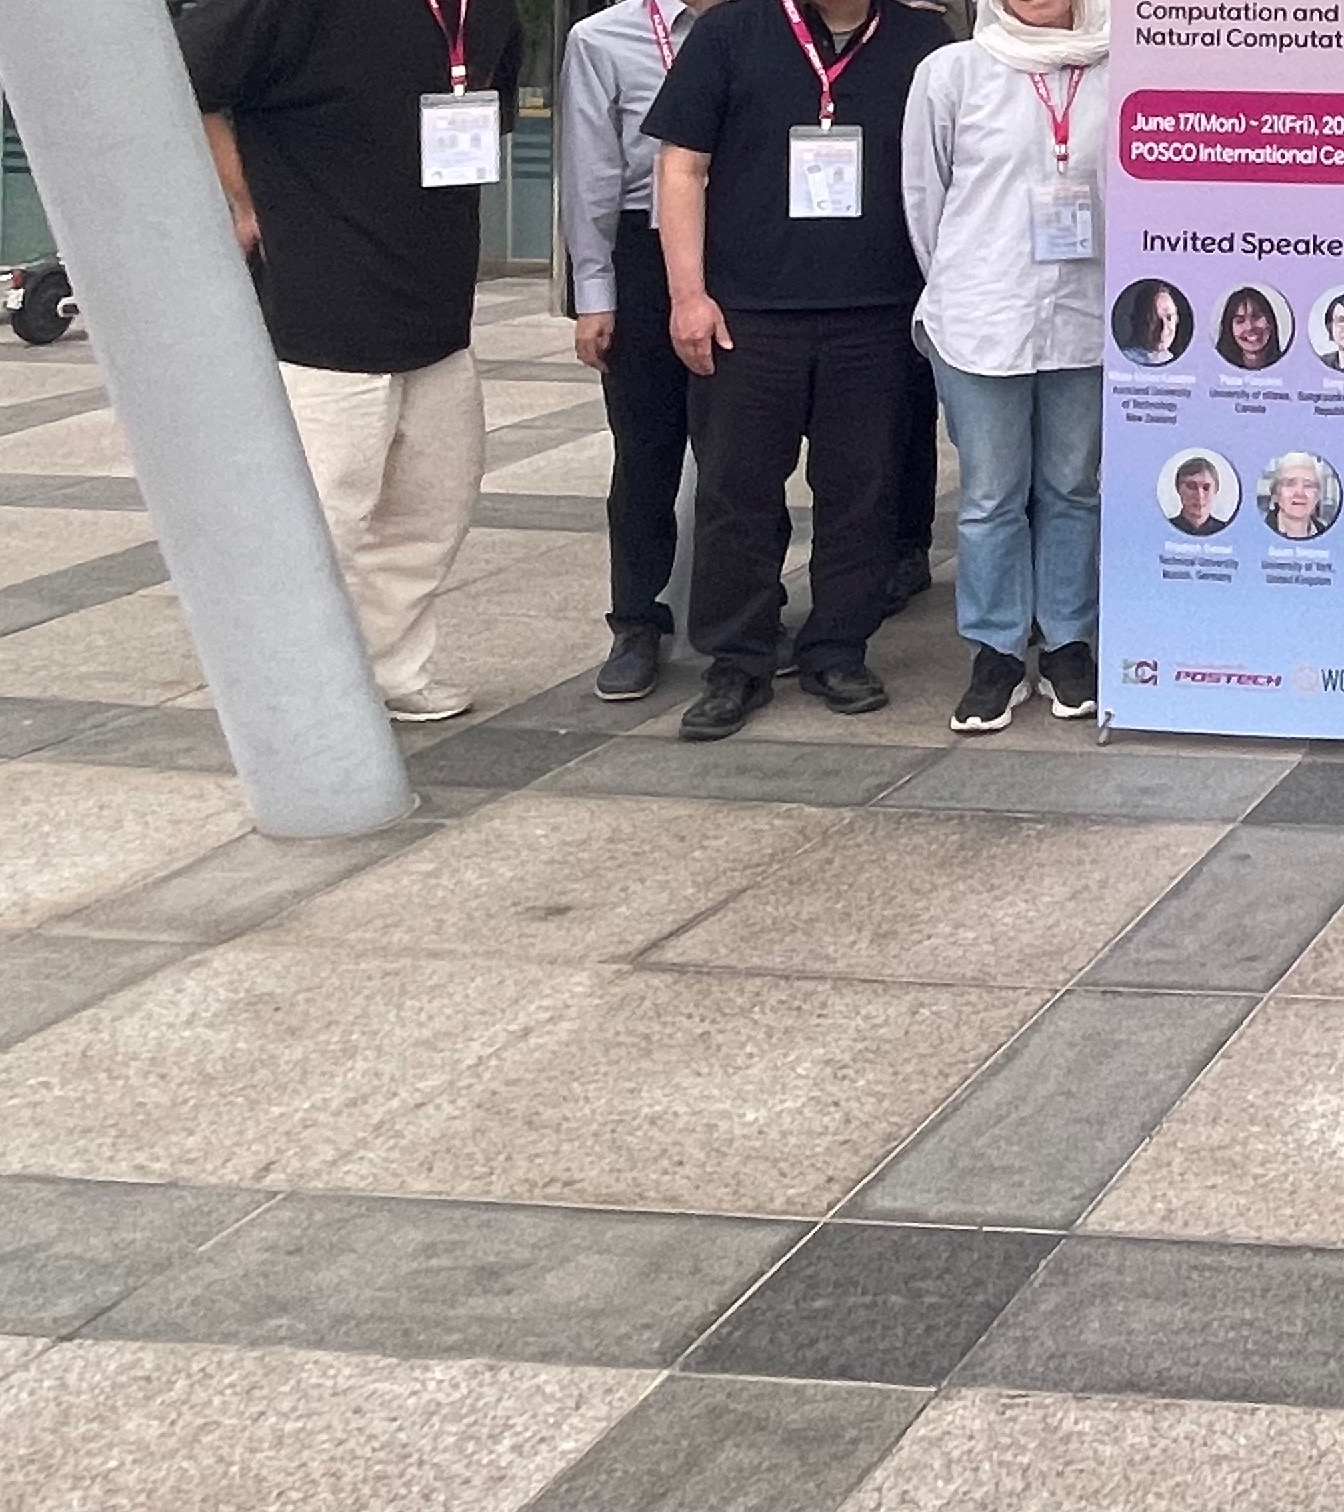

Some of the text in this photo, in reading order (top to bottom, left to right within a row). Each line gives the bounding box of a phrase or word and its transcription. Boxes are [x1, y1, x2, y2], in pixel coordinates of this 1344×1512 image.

[1136, 1, 1340, 25] Computation and
[1136, 27, 1221, 47] Natural
[1131, 112, 1175, 132] June
[1178, 113, 1246, 134] 17(Mon)
[1131, 141, 1197, 162] POSCO
[1199, 143, 1317, 164] International
[1143, 229, 1235, 253] Invited
[1174, 670, 1282, 686] POSTECH
